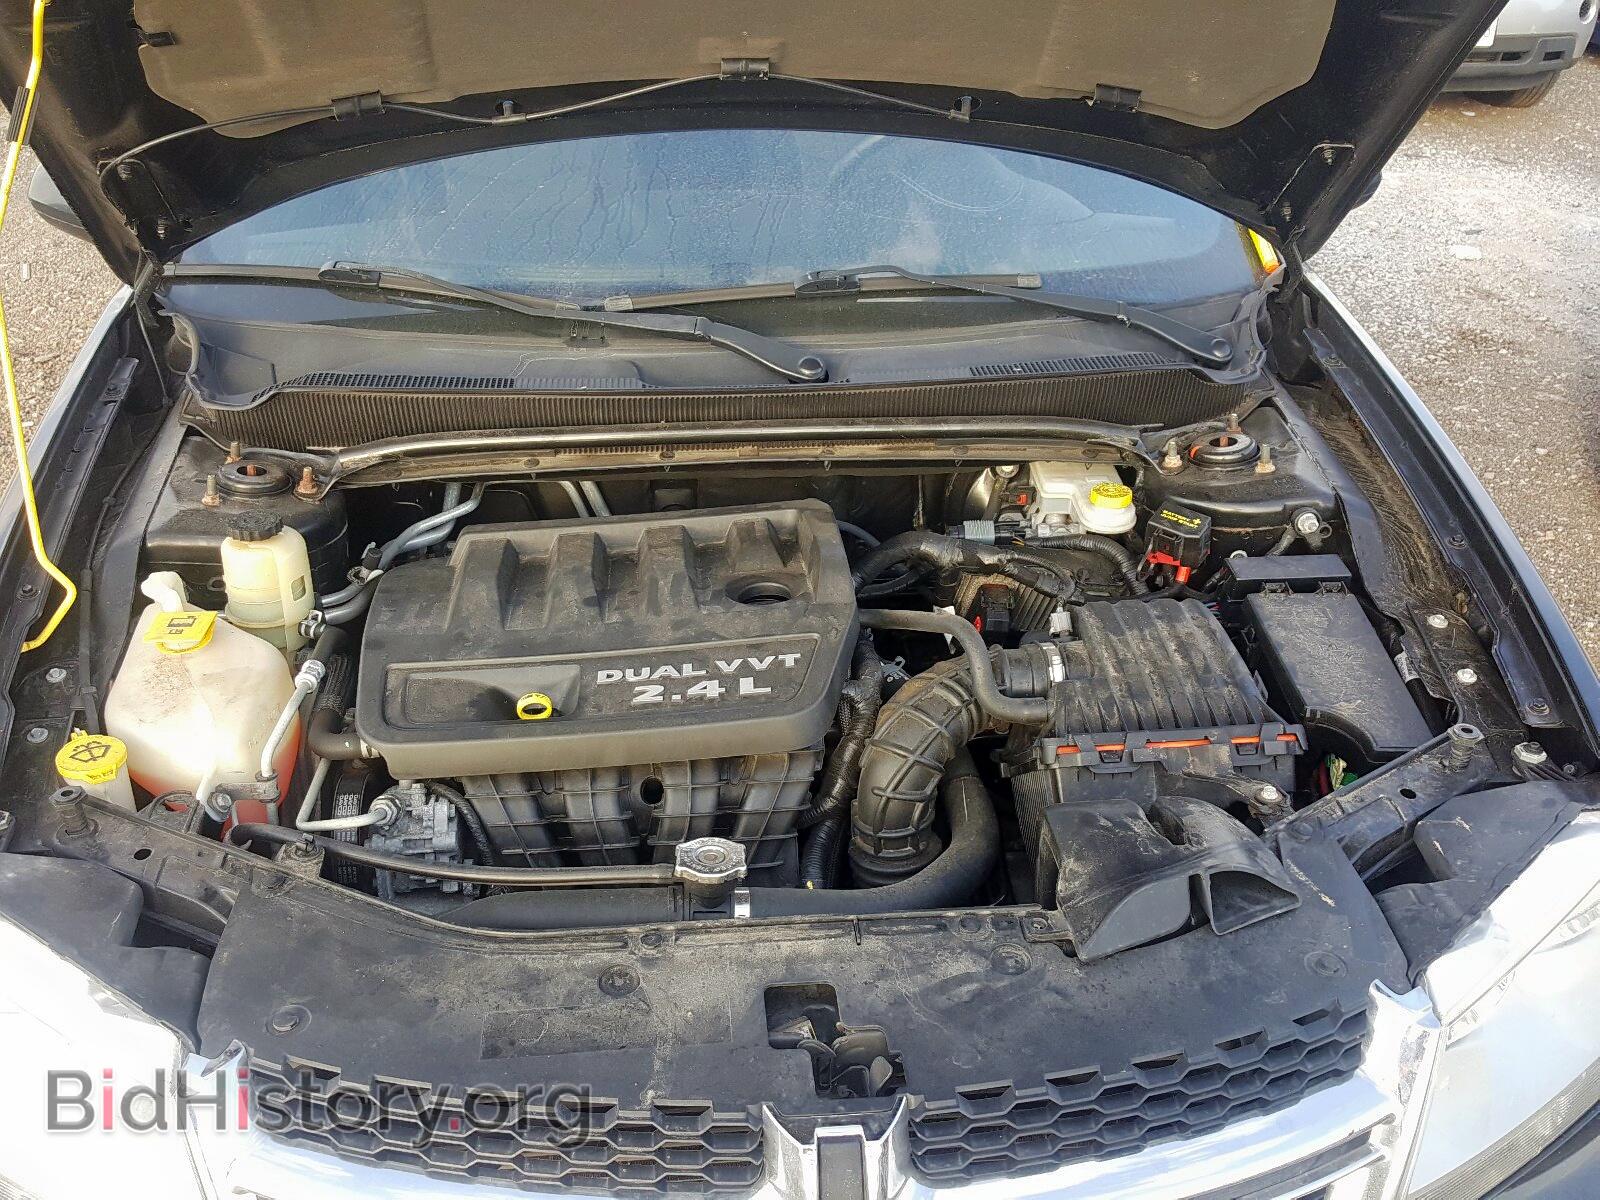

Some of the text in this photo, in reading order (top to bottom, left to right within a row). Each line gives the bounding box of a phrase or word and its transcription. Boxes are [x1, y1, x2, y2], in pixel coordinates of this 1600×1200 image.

[1162, 509, 1190, 521] BATTERY
[1178, 519, 1198, 528] START
[597, 653, 801, 685] DUAL VVT
